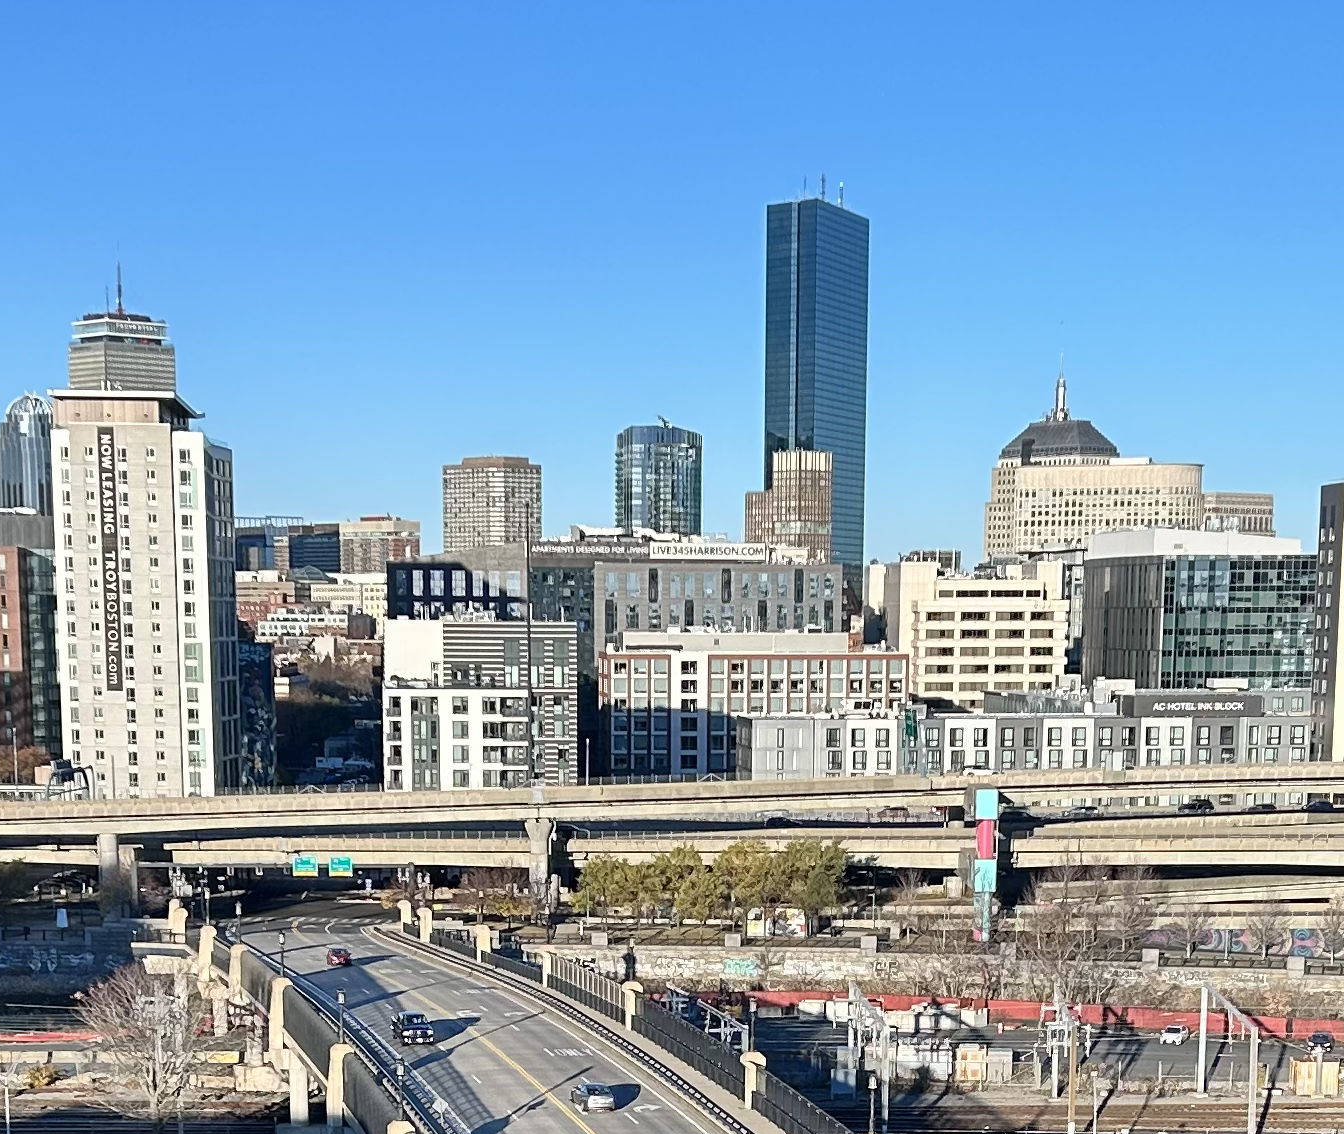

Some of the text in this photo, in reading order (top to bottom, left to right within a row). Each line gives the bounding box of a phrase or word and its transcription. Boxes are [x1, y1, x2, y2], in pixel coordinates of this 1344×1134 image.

[531, 545, 649, 554] APARTMENTS DESIGNED FOR LIVING
[652, 546, 764, 556] LIVE345HARRISON.COM
[100, 434, 119, 685] NOW LEASING TROYBOSTON.com
[1153, 702, 1244, 711] AC HOTEL INK BLOCK
[554, 1048, 594, 1057] ONLY
